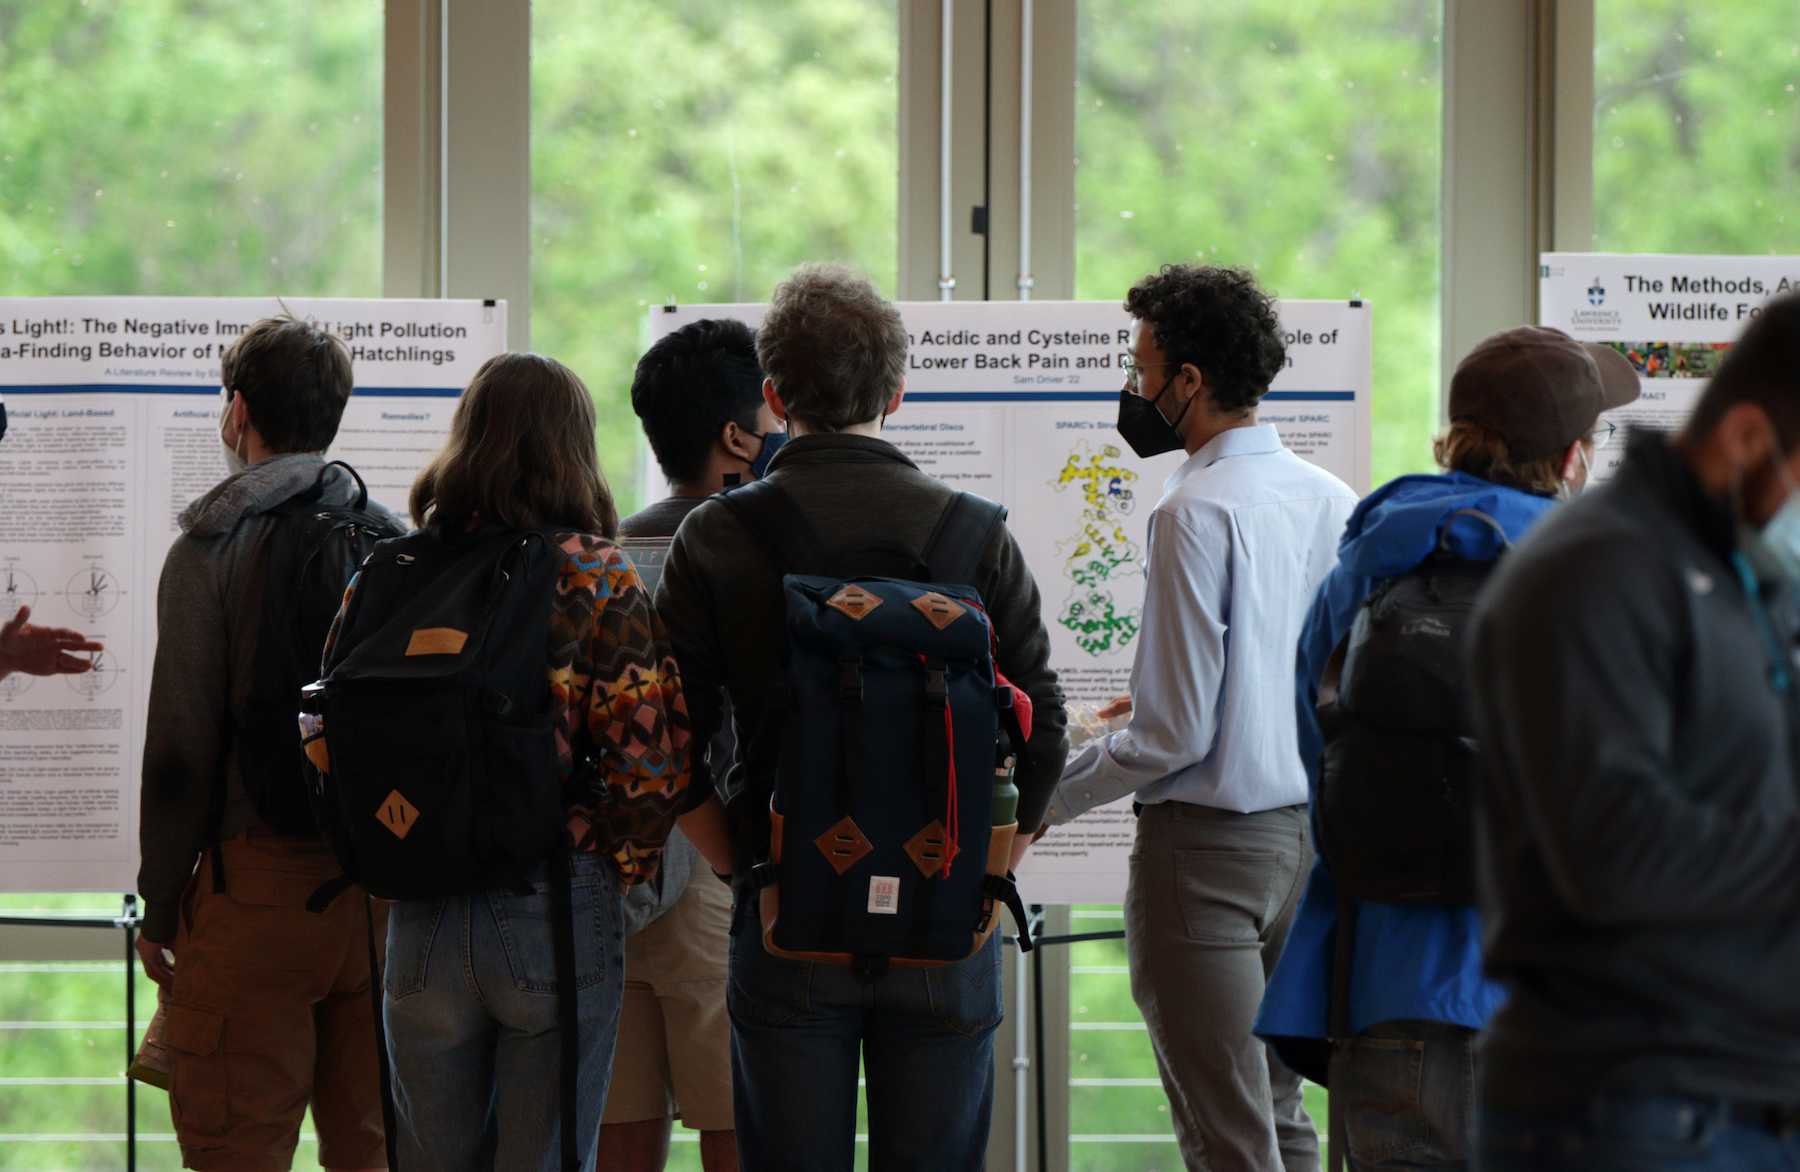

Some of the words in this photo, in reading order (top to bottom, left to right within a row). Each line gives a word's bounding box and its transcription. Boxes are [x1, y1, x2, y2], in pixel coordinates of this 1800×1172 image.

[1624, 275, 1664, 294] The
[1671, 275, 1770, 297] Methods,
[1648, 303, 1729, 321] Wildlife
[12, 319, 75, 338] Light!:
[82, 318, 118, 334] The
[124, 319, 209, 337] Negative
[325, 322, 373, 341] Light
[380, 322, 467, 339] Pollution
[1319, 328, 1339, 345] of
[920, 329, 981, 346] Acidic
[986, 330, 1021, 346] and
[1028, 329, 1110, 349] Cysteine
[99, 342, 187, 359] Behavior
[193, 343, 213, 359] of
[352, 347, 456, 366] Hatchlings
[910, 353, 968, 370] Lower
[975, 353, 1021, 370] Back
[1028, 353, 1070, 369] Pain
[1075, 353, 1111, 369] and
[113, 367, 156, 377] Literature
[159, 368, 193, 378] Review
[1013, 375, 1034, 384] Sam
